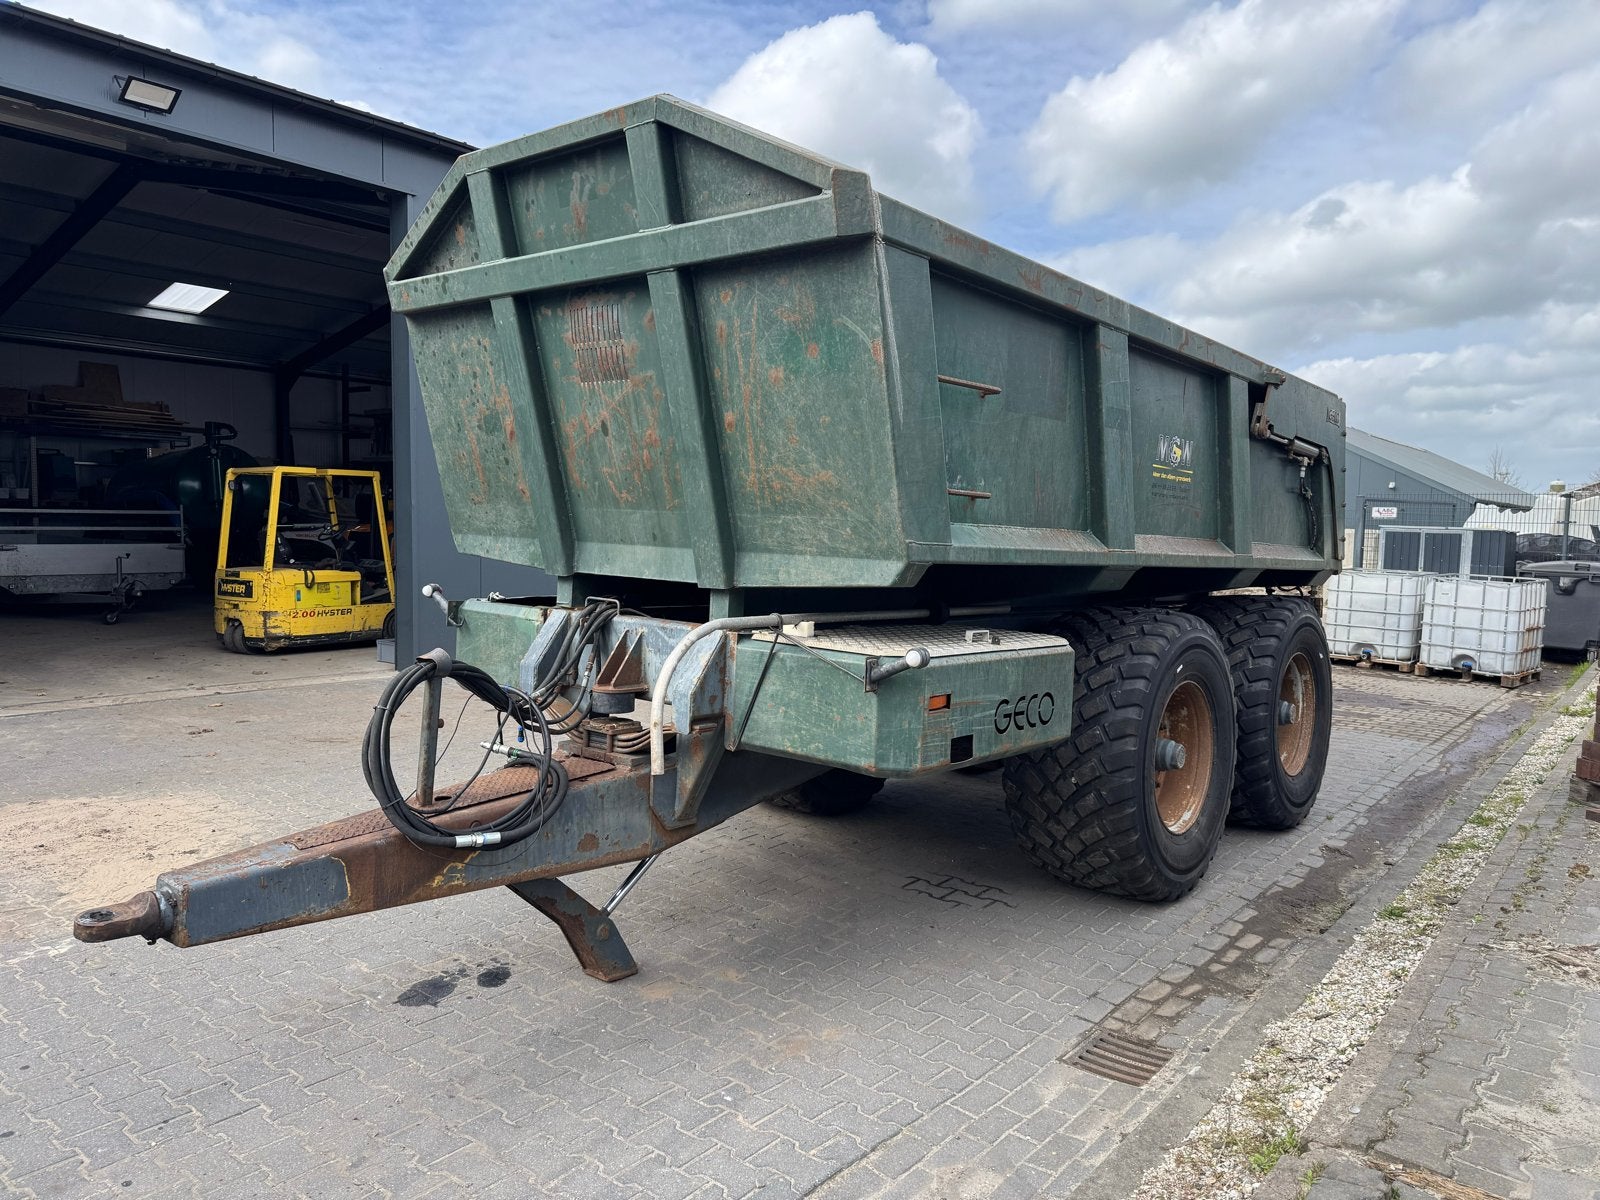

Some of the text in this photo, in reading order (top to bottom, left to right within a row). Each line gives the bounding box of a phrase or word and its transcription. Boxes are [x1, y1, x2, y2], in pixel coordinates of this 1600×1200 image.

[221, 583, 246, 594] HYSTER
[292, 610, 316, 619] 2.00
[317, 608, 353, 617] HYSTER
[994, 691, 1054, 734] GECO
